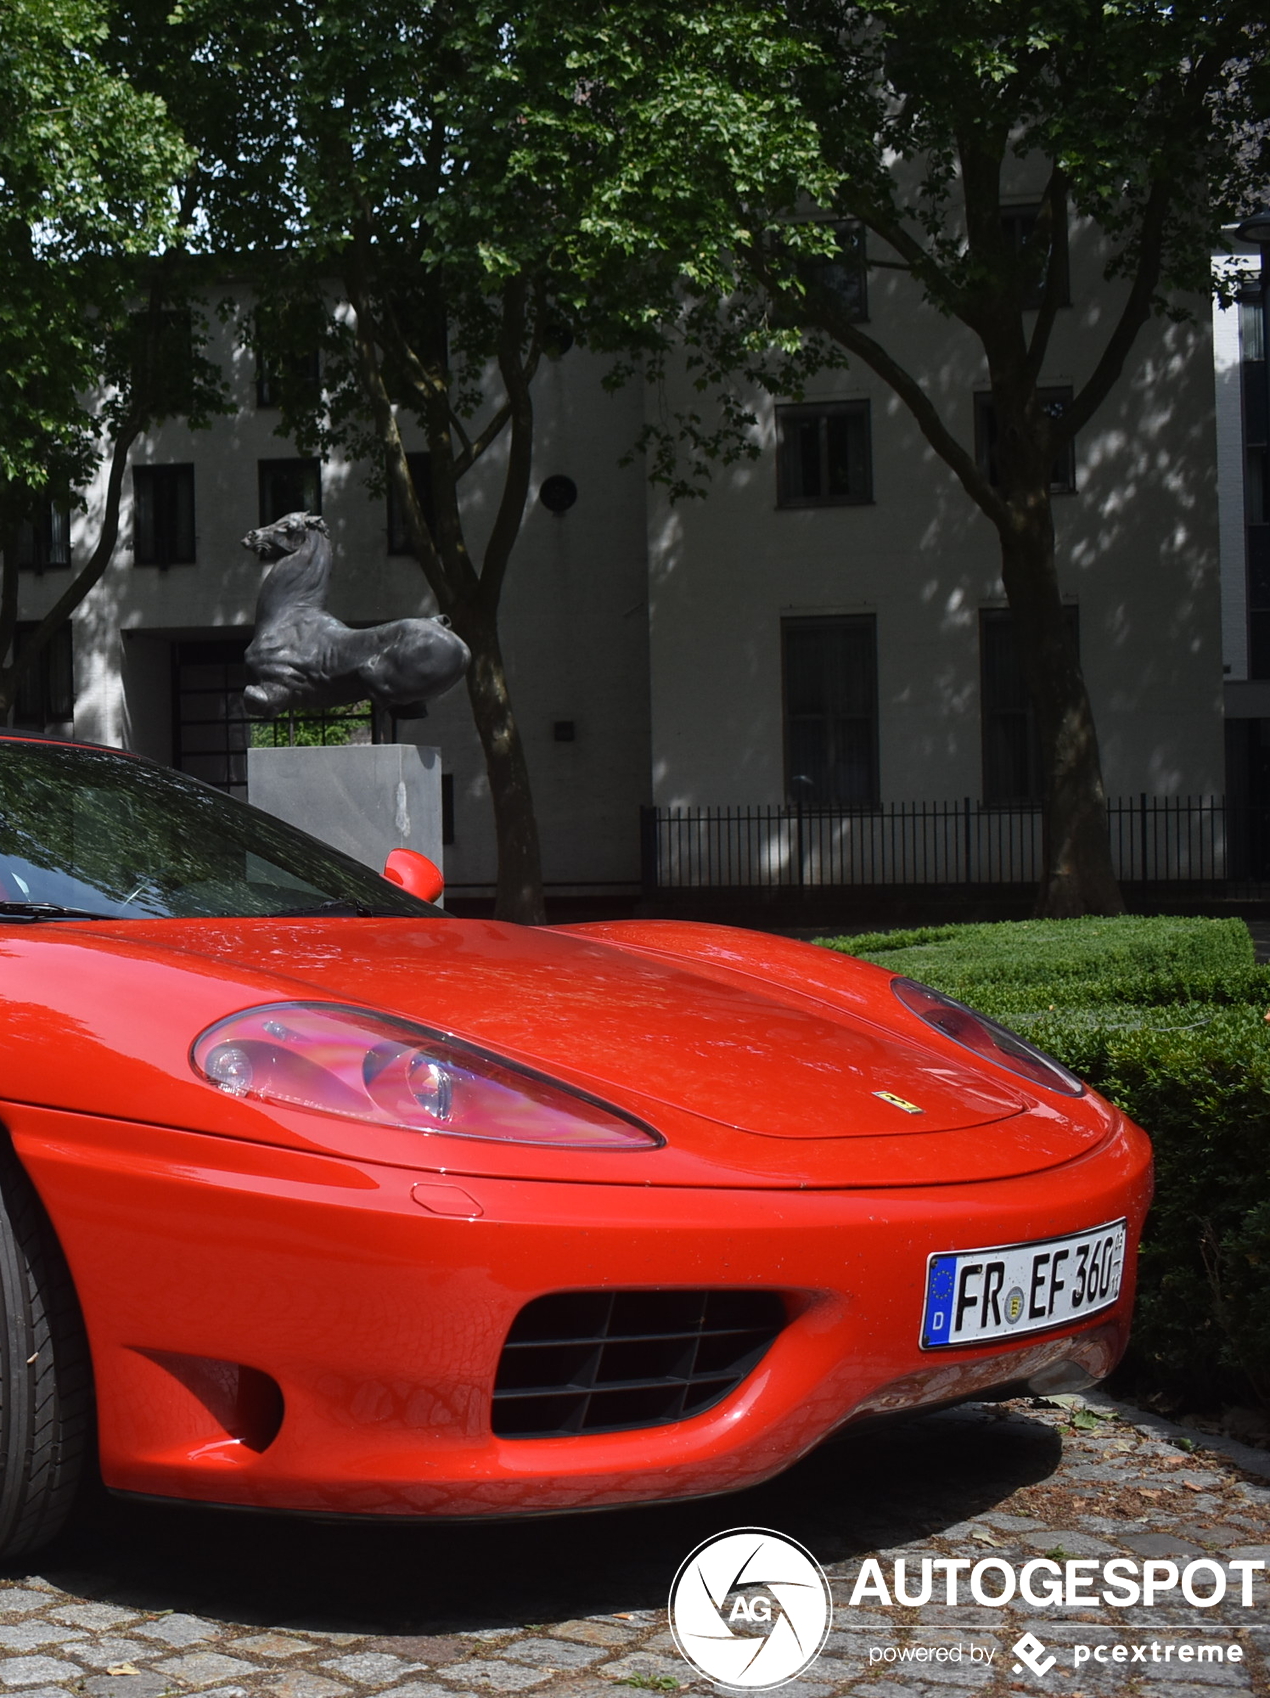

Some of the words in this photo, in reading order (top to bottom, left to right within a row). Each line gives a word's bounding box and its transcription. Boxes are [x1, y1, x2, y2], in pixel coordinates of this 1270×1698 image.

[954, 1261, 1005, 1332] FR
[1028, 1248, 1069, 1319] EF
[1071, 1236, 1113, 1308] 360
[932, 1311, 944, 1331] D
